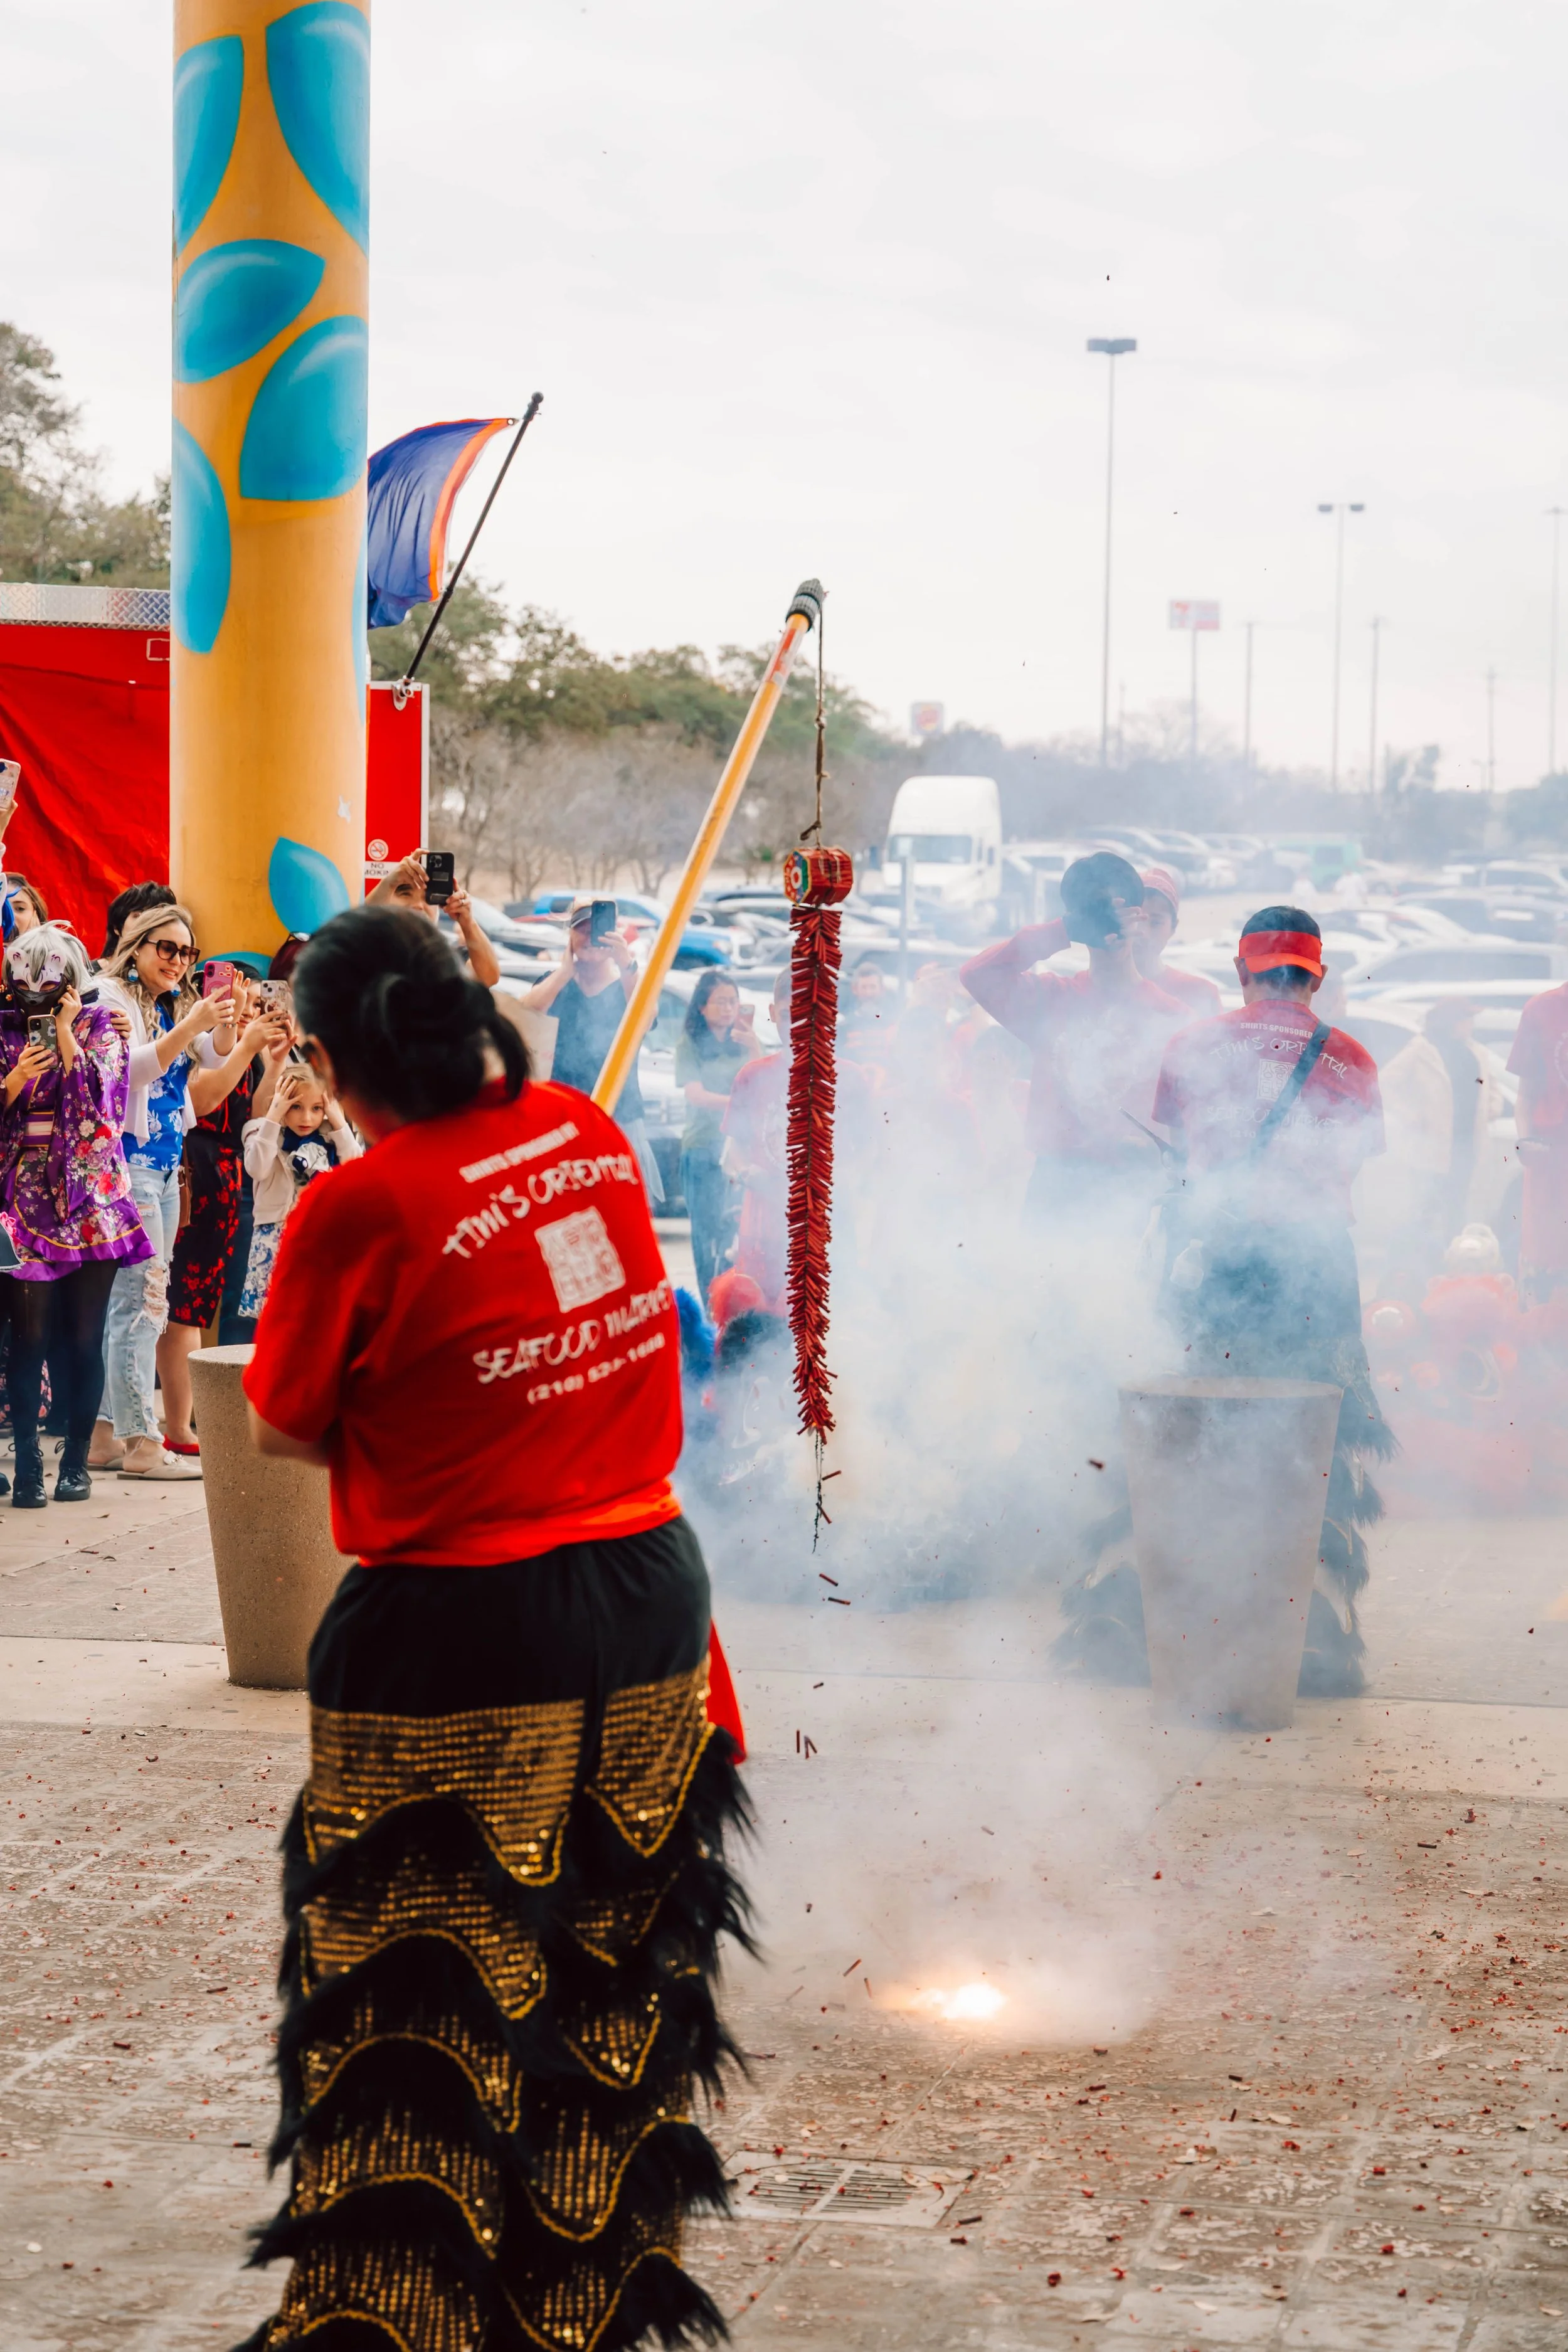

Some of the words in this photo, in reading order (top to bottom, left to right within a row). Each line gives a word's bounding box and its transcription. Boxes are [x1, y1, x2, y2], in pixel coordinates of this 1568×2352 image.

[1240, 1022, 1268, 1030] SHIRTS
[1268, 1024, 1313, 1038] SPONSORED
[1269, 1038, 1348, 1079] ORITAL
[472, 1319, 601, 1384] SEAFOOD
